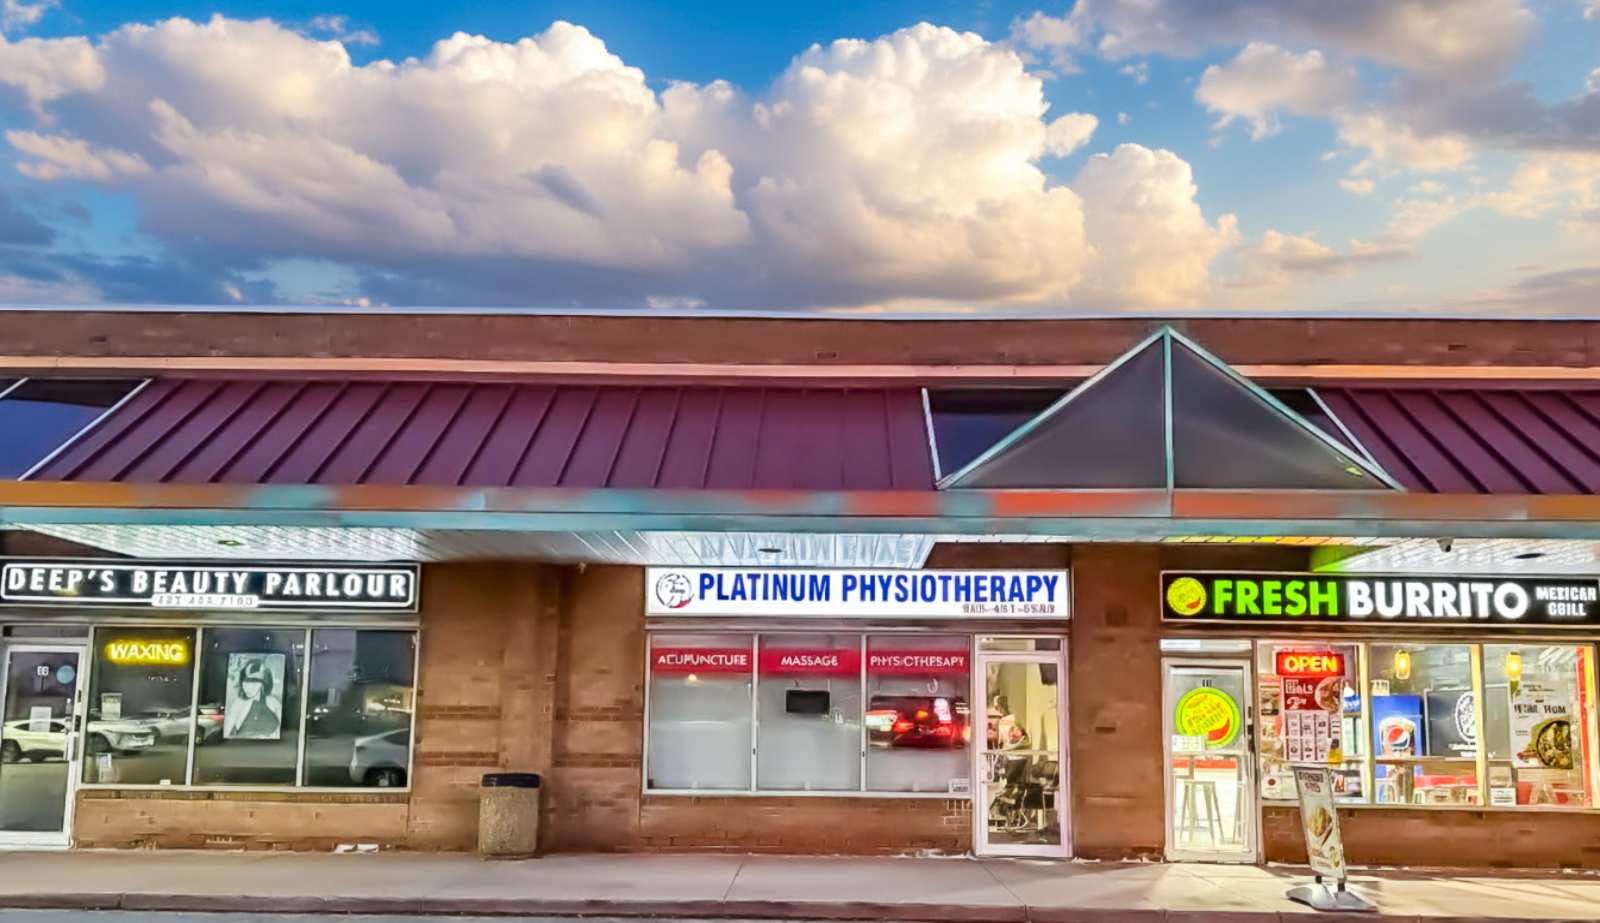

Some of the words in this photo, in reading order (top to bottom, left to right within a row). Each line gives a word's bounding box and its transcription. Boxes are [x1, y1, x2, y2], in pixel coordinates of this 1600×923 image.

[8, 568, 114, 591] DEEP'S
[133, 571, 248, 594] BEAUTY
[266, 573, 407, 597] PARLOUR
[699, 573, 831, 602] PLATINUM
[842, 575, 1059, 603] PHYSIOTHERAPY
[1214, 580, 1338, 616] FRESH
[1348, 581, 1528, 619] BURRITO
[1535, 586, 1597, 601] MEXICAN
[110, 643, 184, 661] WAXING
[657, 654, 748, 666] ACUPUNCTURE
[780, 655, 839, 667] MASSAGE
[1284, 655, 1338, 673] OPEN
